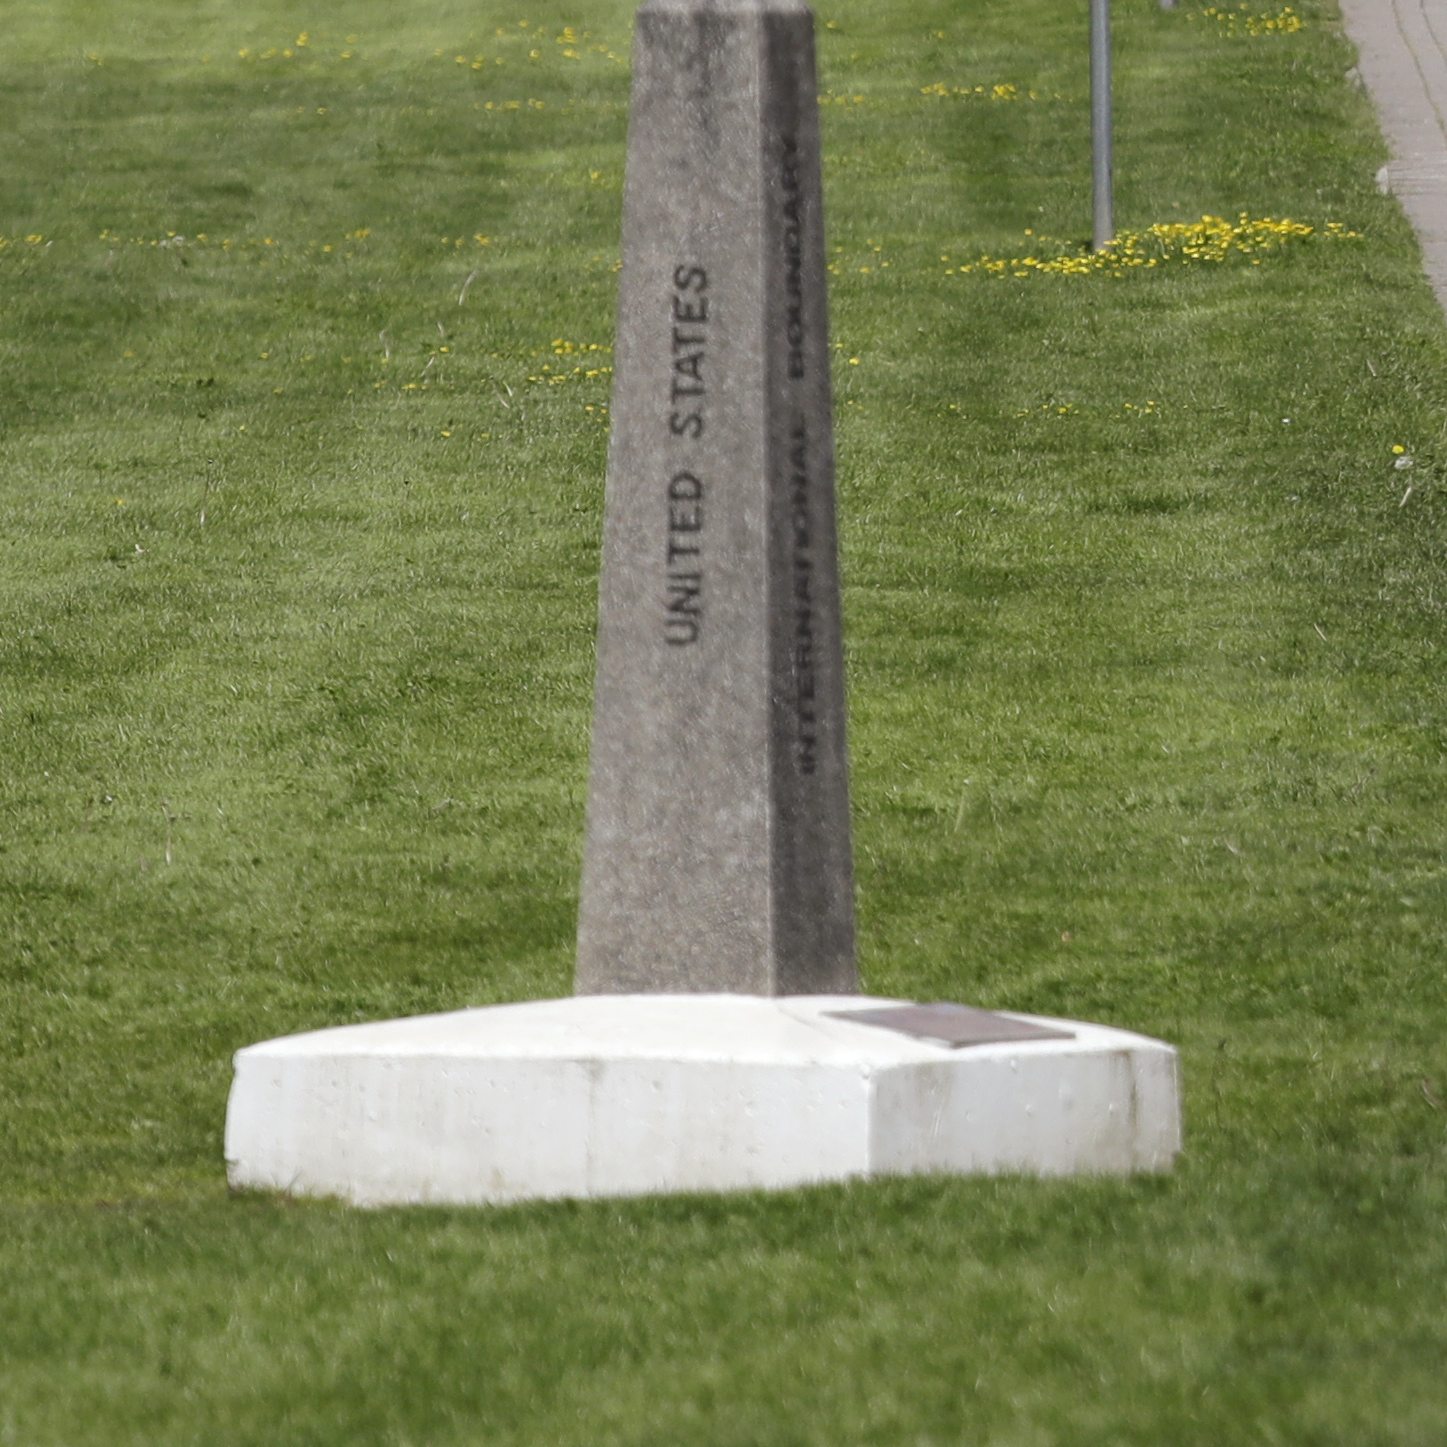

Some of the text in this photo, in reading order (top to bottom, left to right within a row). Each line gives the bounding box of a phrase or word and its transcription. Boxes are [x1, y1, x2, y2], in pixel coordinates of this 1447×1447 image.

[664, 262, 710, 648] UNITED STATES
[780, 131, 818, 776] INTERNATIONAL BOUNDARY
